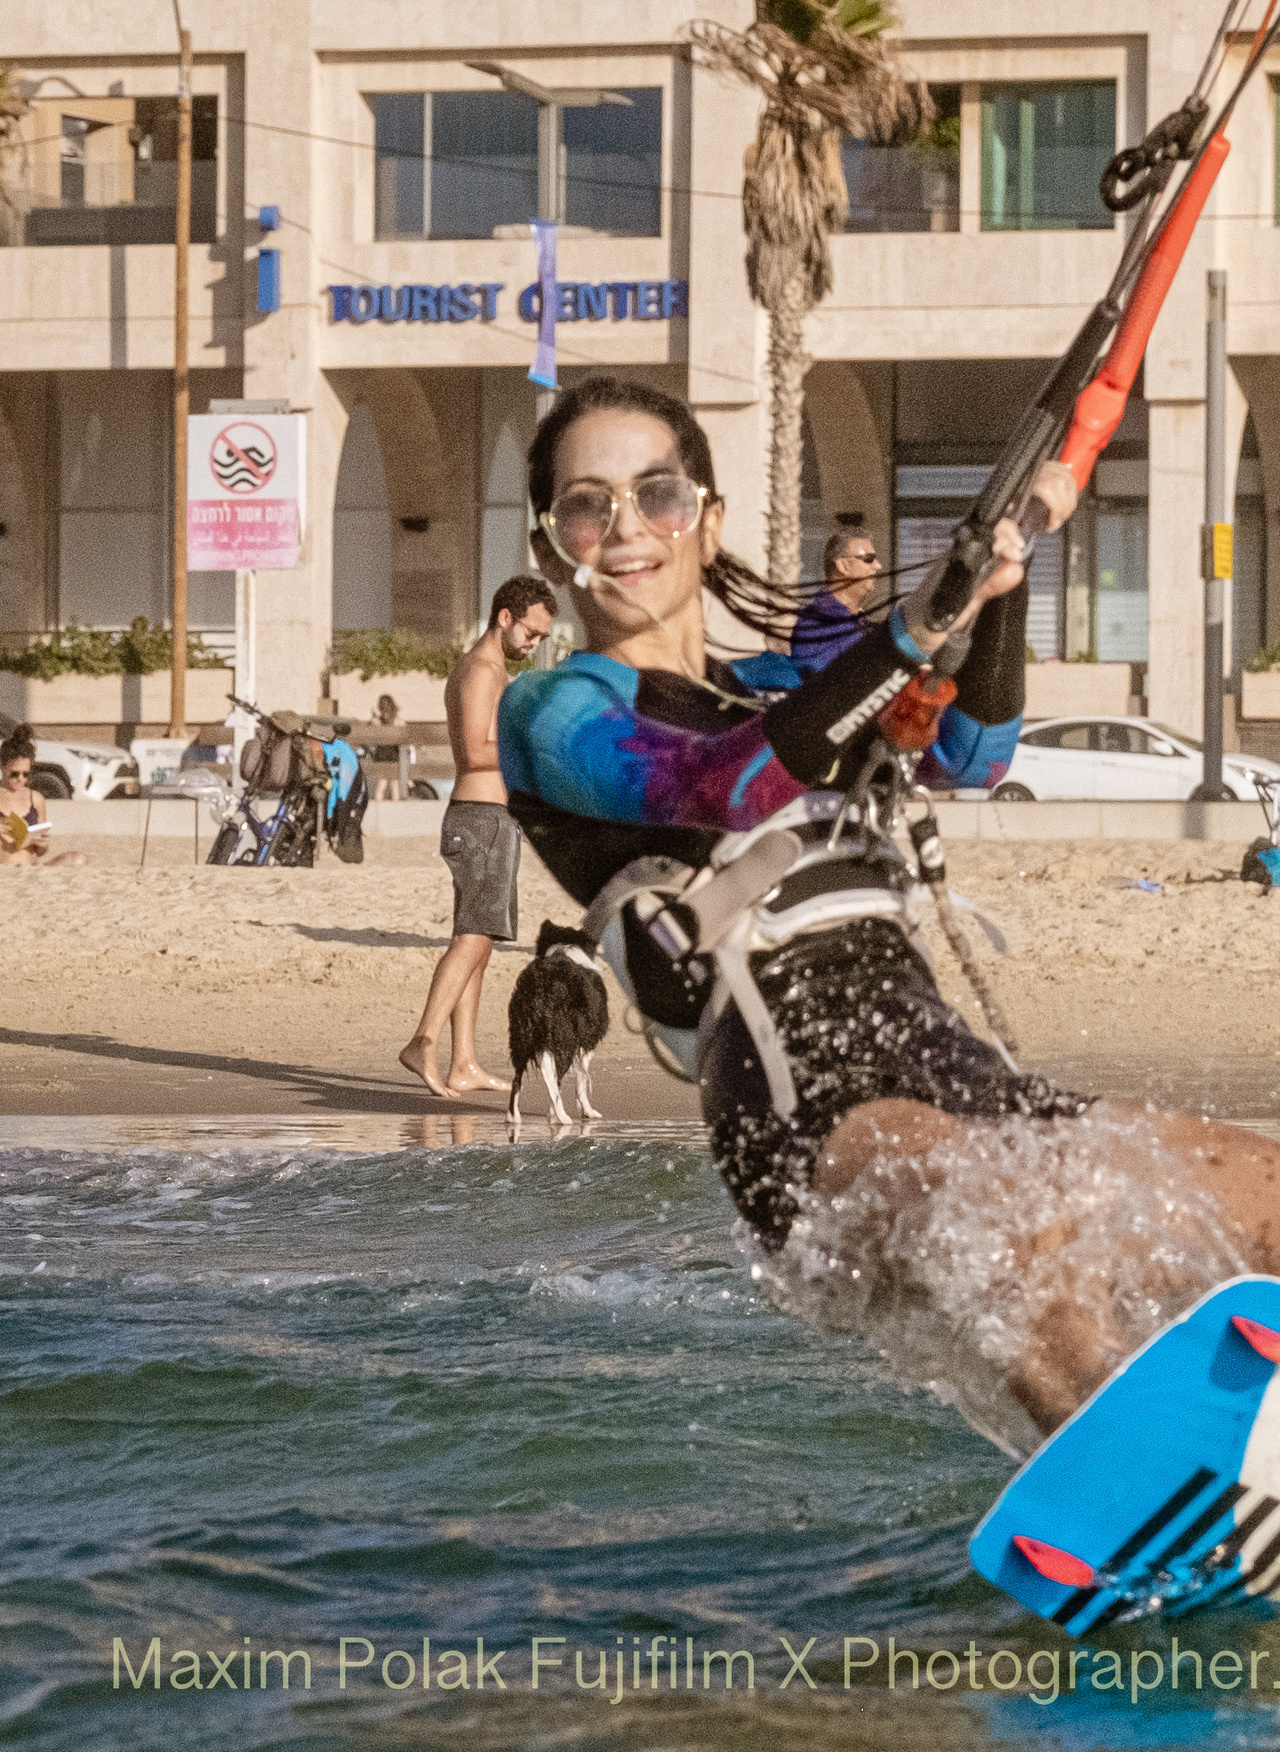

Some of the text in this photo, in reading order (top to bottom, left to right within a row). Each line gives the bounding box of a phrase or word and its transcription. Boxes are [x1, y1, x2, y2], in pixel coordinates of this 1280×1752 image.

[328, 281, 689, 324] TOURIST CENTER
[838, 668, 911, 735] MYSTIC
